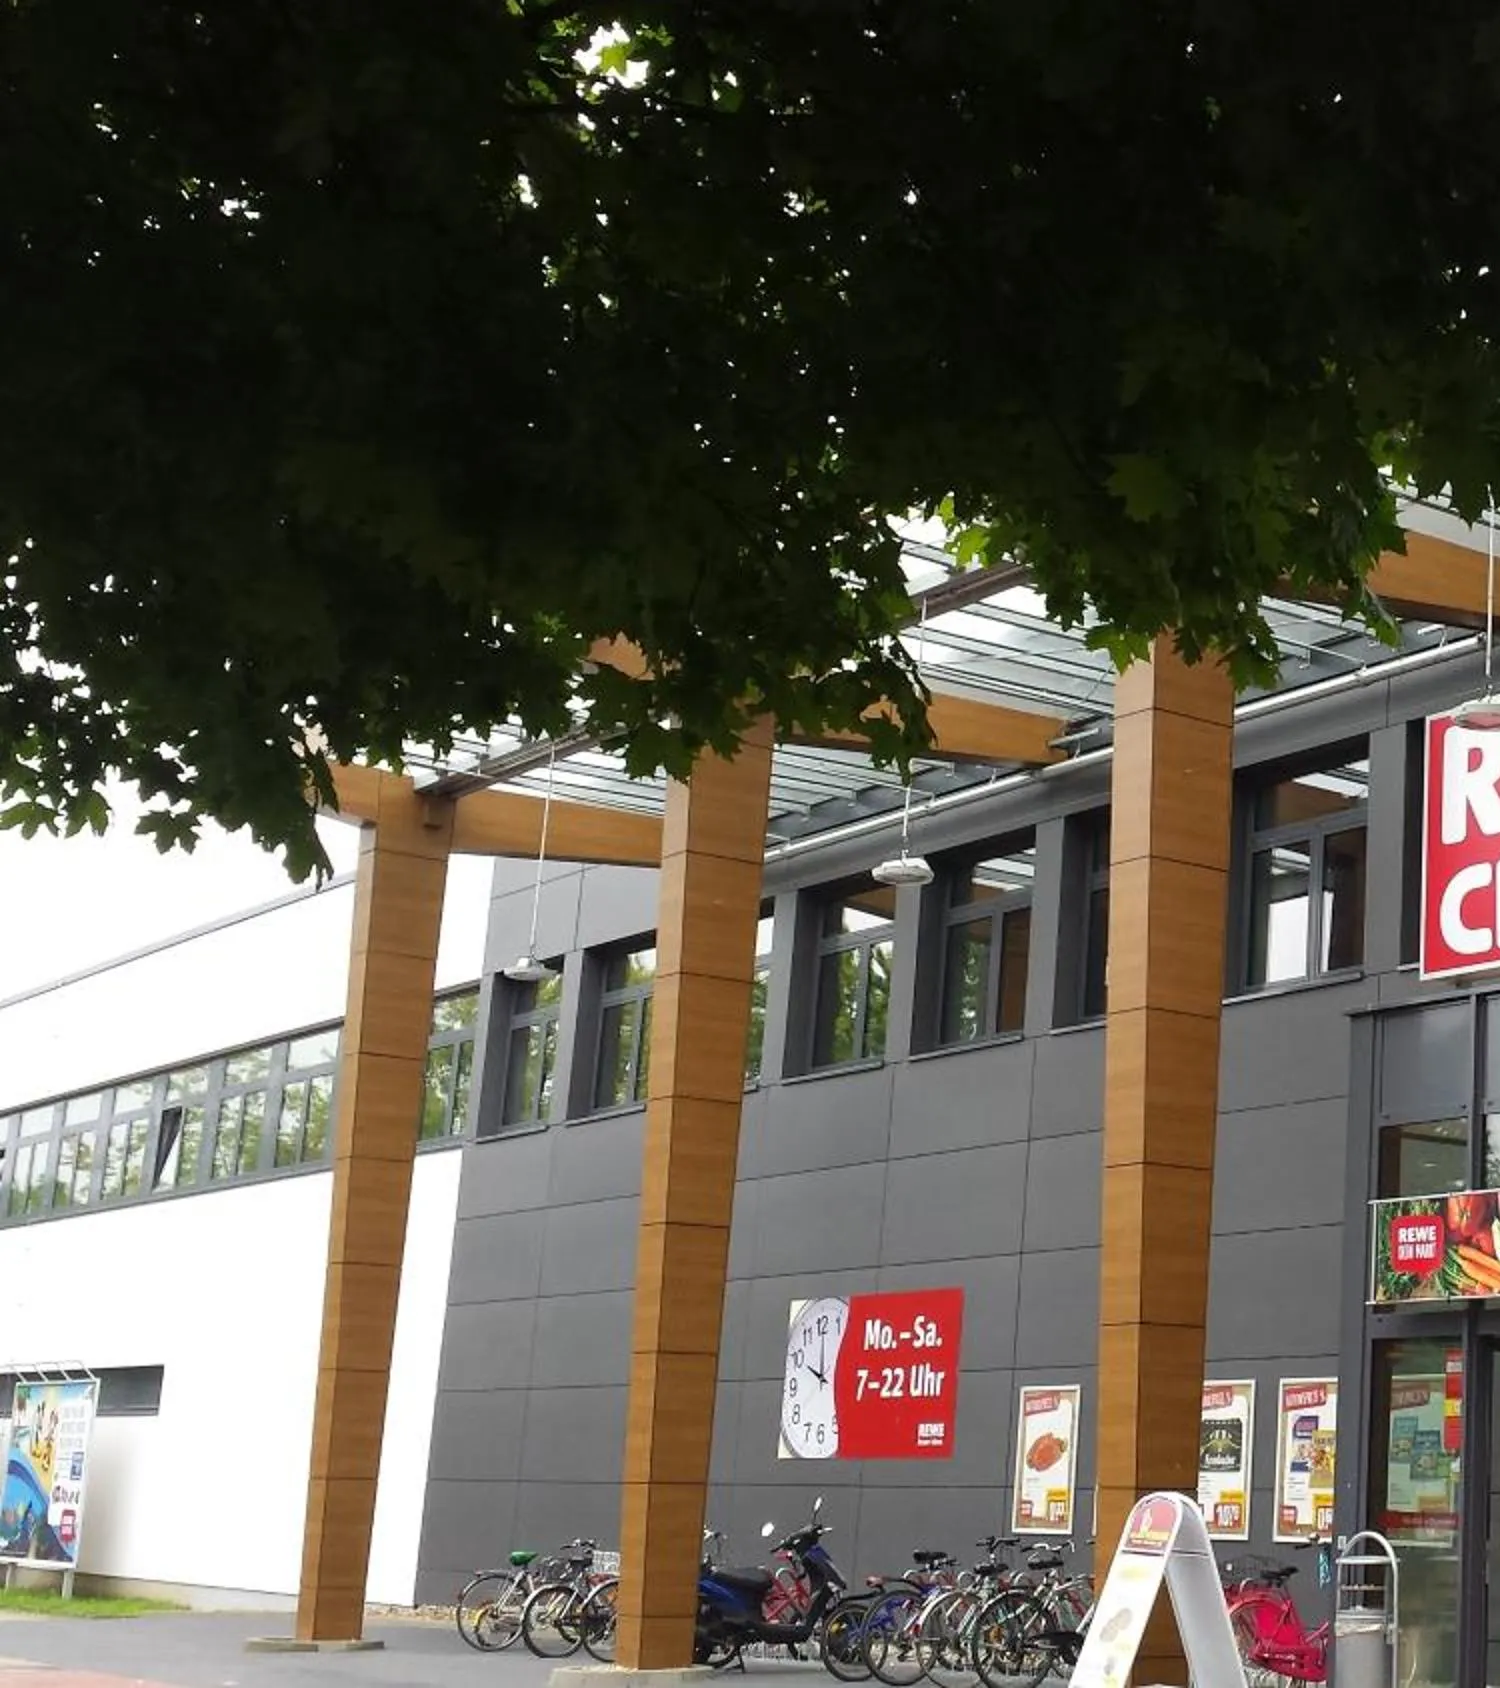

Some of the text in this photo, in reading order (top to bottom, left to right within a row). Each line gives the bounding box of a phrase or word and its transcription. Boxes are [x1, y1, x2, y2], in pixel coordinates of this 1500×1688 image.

[1398, 1225, 1436, 1243] REWE
[803, 1326, 813, 1346] 11
[817, 1315, 829, 1337] 12
[789, 1377, 798, 1398] 9
[856, 1363, 945, 1402] 7-22 Uhr
[791, 1404, 801, 1425] 8
[803, 1422, 813, 1443] 7
[816, 1423, 826, 1445] 6
